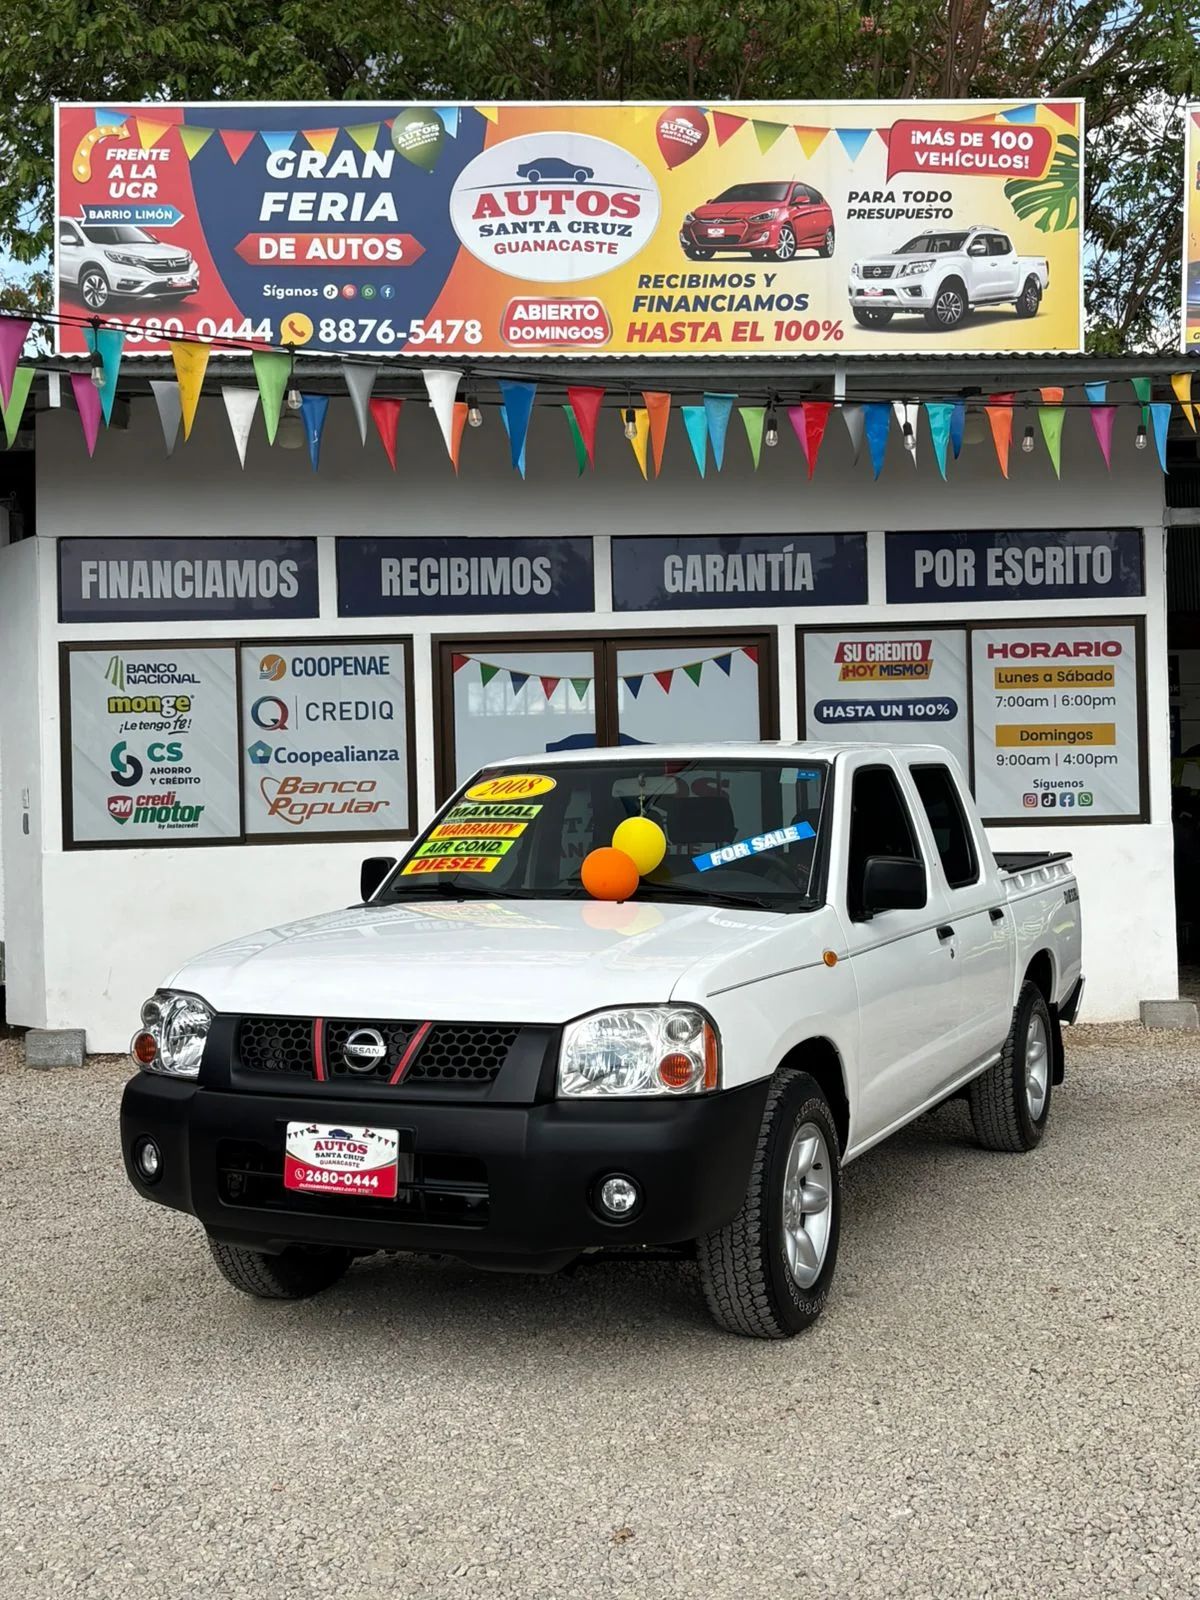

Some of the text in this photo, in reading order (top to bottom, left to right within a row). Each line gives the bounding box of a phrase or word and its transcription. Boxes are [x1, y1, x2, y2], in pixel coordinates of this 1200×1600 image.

[398, 124, 440, 145] AUTOS
[660, 121, 703, 139] AUTOS
[911, 129, 1034, 149] ¡MÁS DE 100
[105, 148, 171, 161] FRENTE
[914, 150, 1030, 170] VEHÍCULOS!
[107, 164, 157, 179] A LA
[265, 149, 396, 179] GRAN
[109, 181, 158, 199] UCR
[847, 190, 953, 204] PARA TODO
[89, 207, 173, 220] BARRIO LIMÓN
[258, 191, 399, 222] FERIA
[472, 190, 641, 220] AUTOS
[846, 207, 954, 221] PRESUPUESTO
[479, 219, 633, 238] SANTA CRUZ
[258, 237, 403, 260] DE AUTOS
[493, 240, 619, 255] GUANACASTE
[637, 273, 777, 289] RECIBIMOS Y
[262, 284, 318, 299] Síganos
[632, 293, 809, 313] FINANCIAMOS
[512, 303, 599, 321] ABIERTO
[318, 319, 483, 345] 8876-5478
[508, 326, 605, 341] DOMINGOS
[626, 320, 845, 343] HASTA EL 100%
[664, 543, 815, 593] GARANTÍA
[914, 545, 1113, 589] POR ESCRITO
[81, 559, 299, 599] FINANCIAMOS
[380, 556, 552, 597] RECIBIMOS
[843, 641, 922, 662] SU CRÉDITO
[987, 640, 1123, 659] HORARIO
[126, 663, 177, 674] BANCO
[291, 656, 390, 678] COOPENAE
[842, 664, 929, 680] ¡HOY MISMO!
[126, 673, 201, 685] NACIONAL
[998, 669, 1113, 684] Lunes a Sábado
[107, 695, 192, 718] monge
[995, 694, 1116, 709] 7:00am 6:00pm
[305, 700, 394, 722] CREDIQ
[822, 703, 950, 718] HASTA UN 100%
[119, 720, 138, 734] ¡Le
[138, 721, 171, 732] tengo
[1020, 728, 1093, 744] Domingos
[147, 742, 184, 762] CS
[274, 745, 400, 766] Coopealianza
[996, 753, 1118, 768] 9:00am 4:00pm
[150, 766, 192, 775] AHORRO
[150, 775, 201, 786] Y CRÉDITO
[277, 776, 377, 795] Banco
[478, 777, 543, 797] 2008
[1032, 778, 1084, 791] Síguenos
[109, 800, 131, 813] CM
[136, 791, 176, 806] credi
[133, 801, 205, 824] motor
[268, 797, 390, 820] Popular
[448, 804, 535, 818] MANUAL
[436, 822, 520, 837] WARRANTY
[424, 841, 454, 854] AIR
[710, 843, 751, 867] FOR
[751, 826, 801, 851] SALE
[411, 857, 487, 872] DIESEL
[346, 1045, 380, 1056] NISSAN
[313, 1140, 368, 1155] AUTOS
[315, 1151, 365, 1162] SANTA CRUZ
[319, 1159, 360, 1168] GUANACASTE
[305, 1169, 379, 1188] 2680-0444
